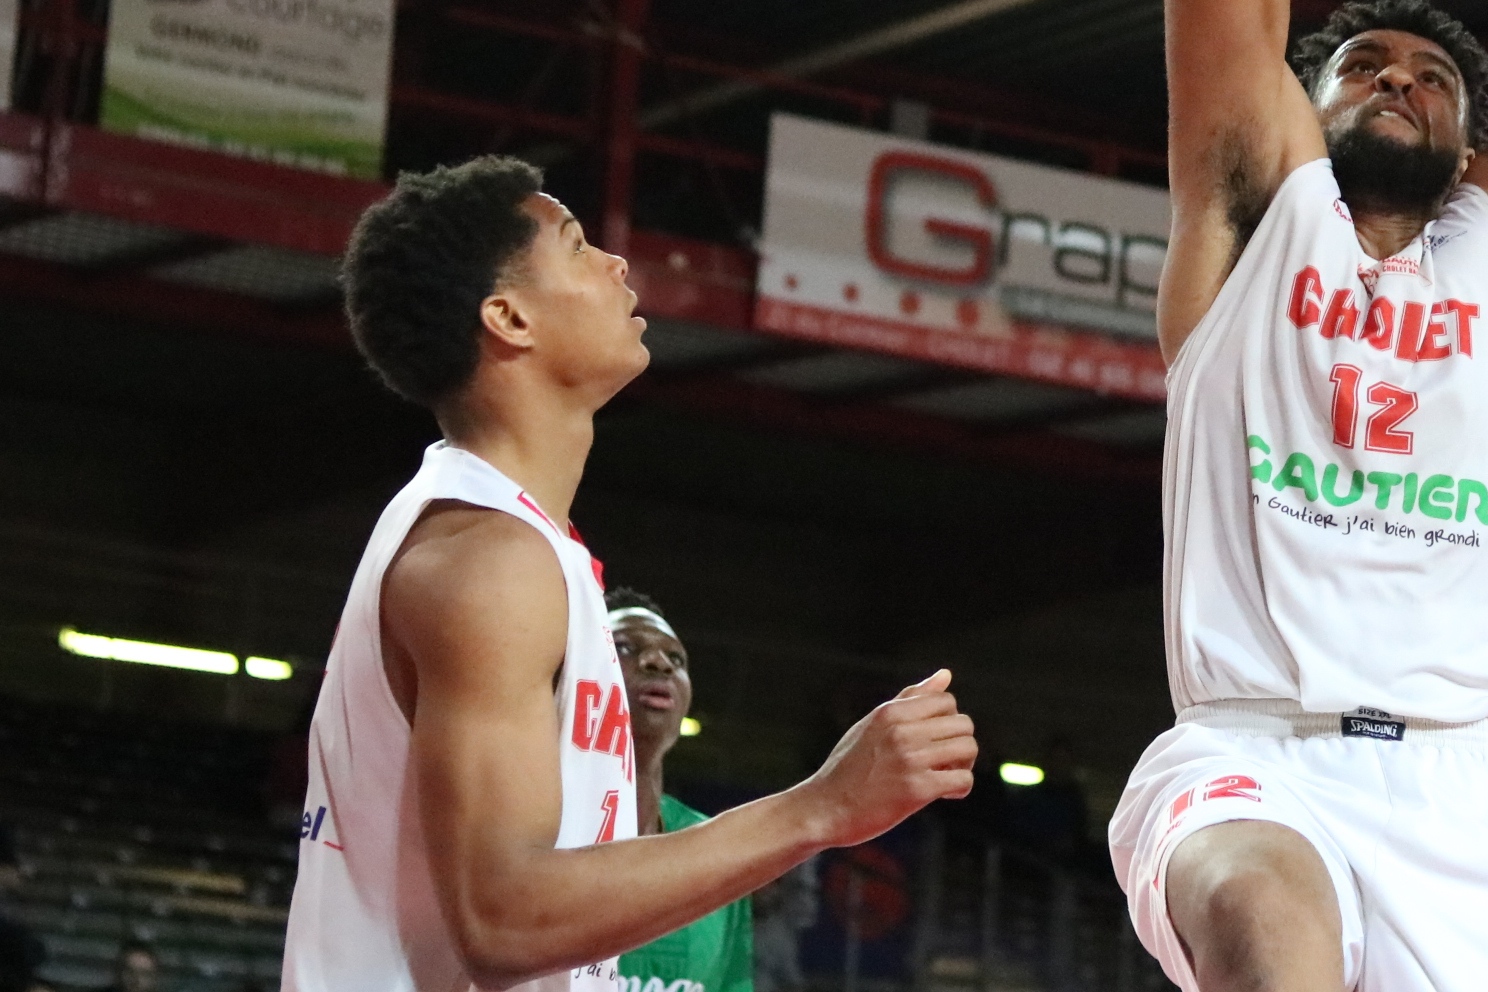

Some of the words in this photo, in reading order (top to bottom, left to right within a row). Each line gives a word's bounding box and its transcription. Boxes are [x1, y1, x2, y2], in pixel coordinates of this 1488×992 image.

[1286, 264, 1480, 362] CHOLET
[1329, 363, 1419, 455] 12
[1341, 515, 1375, 535] j'ai
[1384, 520, 1416, 539] bien
[1350, 719, 1398, 737] SPALDING
[300, 805, 327, 841] el
